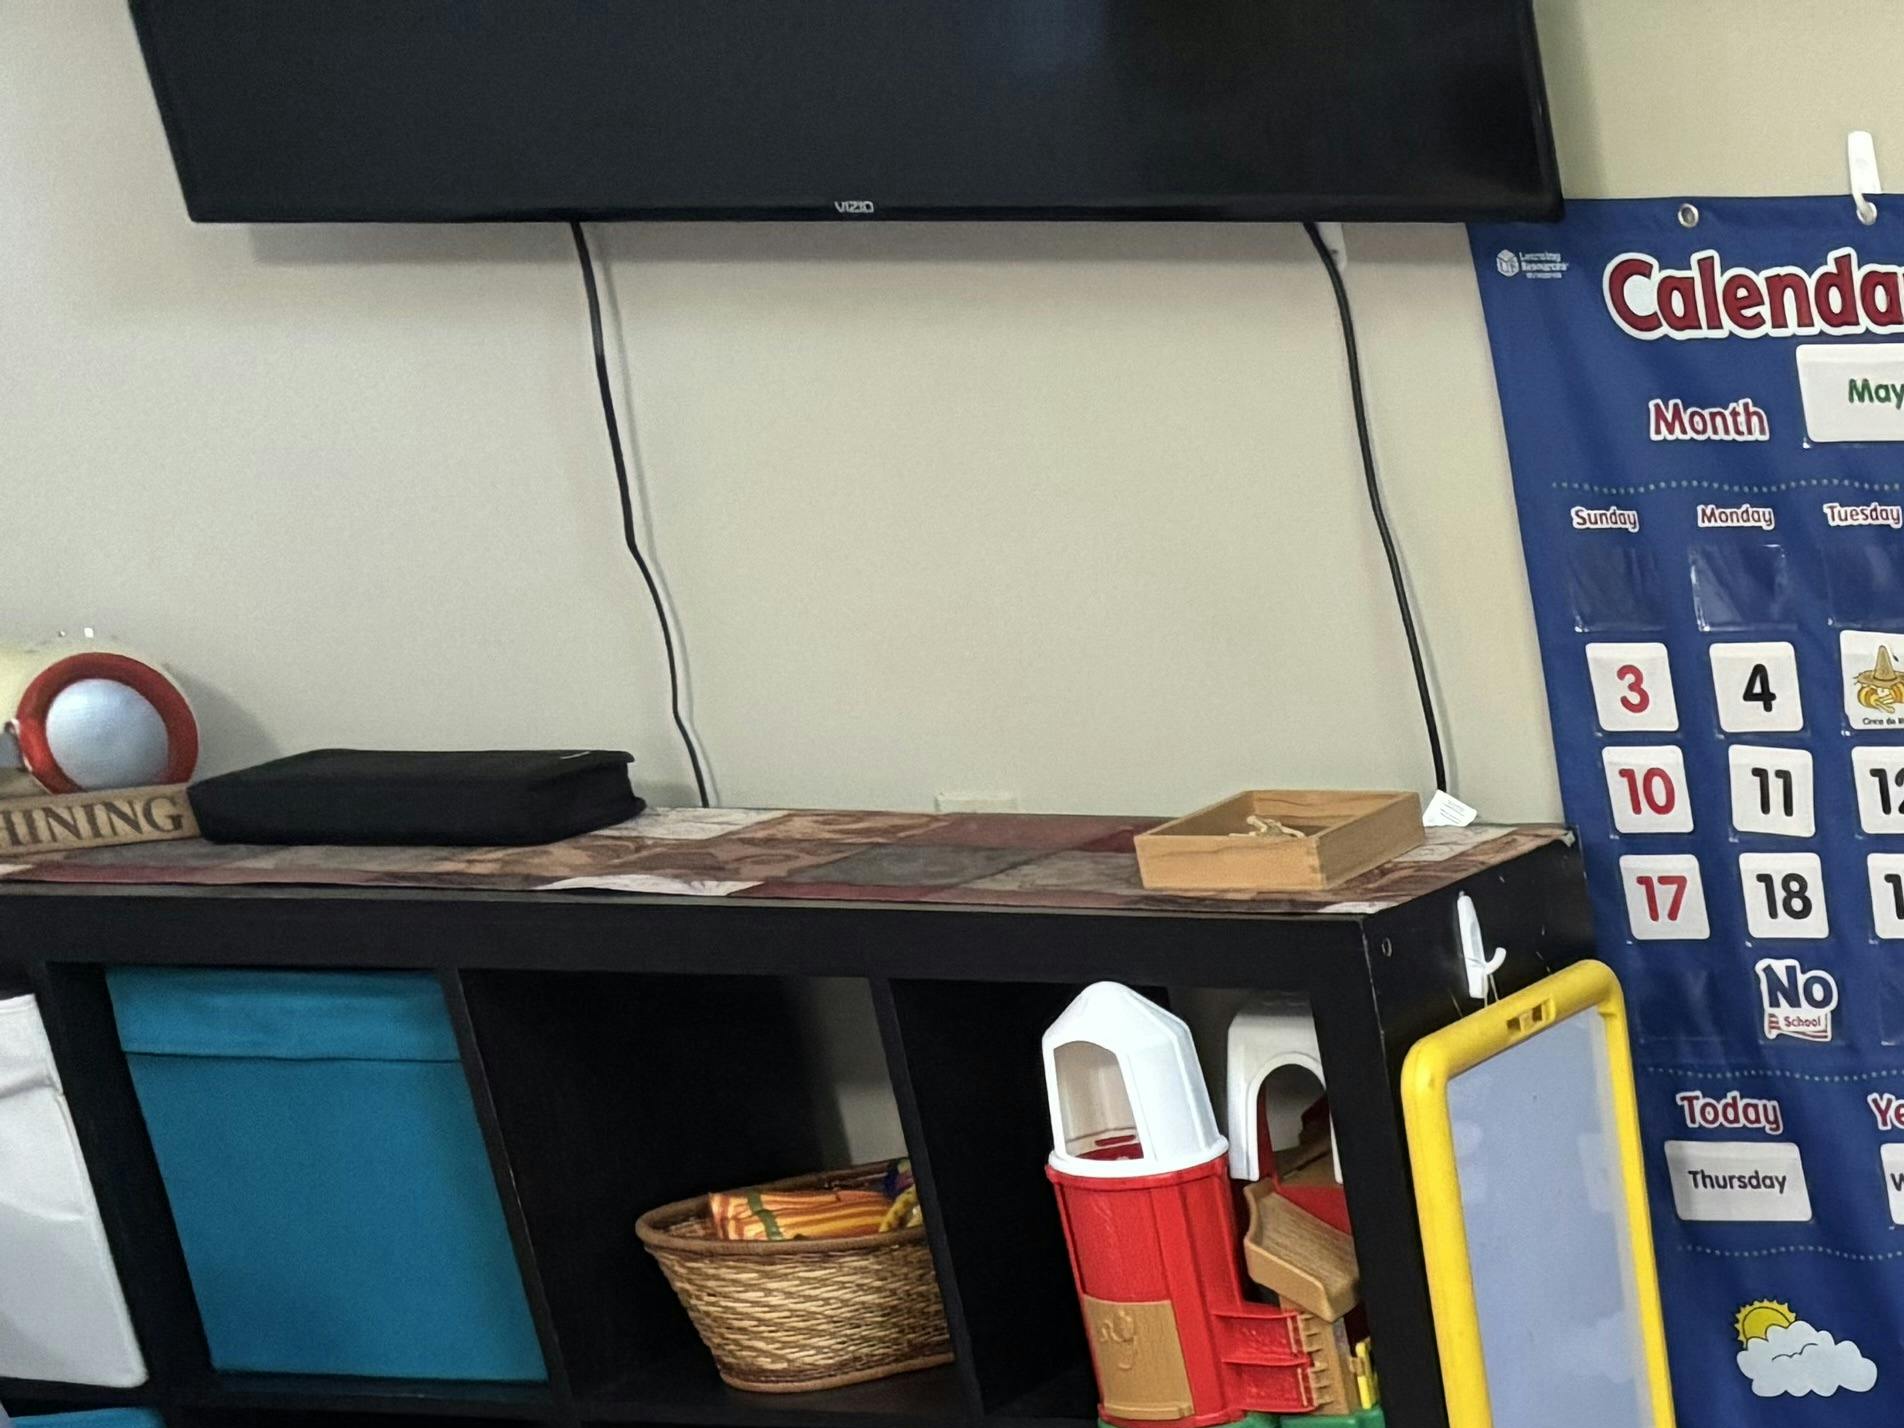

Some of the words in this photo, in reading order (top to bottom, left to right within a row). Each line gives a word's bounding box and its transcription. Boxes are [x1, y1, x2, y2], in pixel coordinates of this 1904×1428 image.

[834, 201, 874, 213] VIZIO
[1653, 401, 1767, 439] Month
[1574, 508, 1638, 531] Sunday
[1699, 506, 1774, 530] Monday
[1827, 504, 1901, 527] Tuesday
[1616, 664, 1650, 714] 3
[1742, 663, 1776, 713] 4
[1618, 767, 1675, 815] 10
[1752, 767, 1794, 817] 11
[1636, 875, 1687, 922] 17
[1757, 872, 1812, 920] 18
[1762, 965, 1833, 1009] No
[1784, 1014, 1821, 1028] School
[1677, 1093, 1782, 1133] Today
[1688, 1169, 1787, 1194] Thursday
